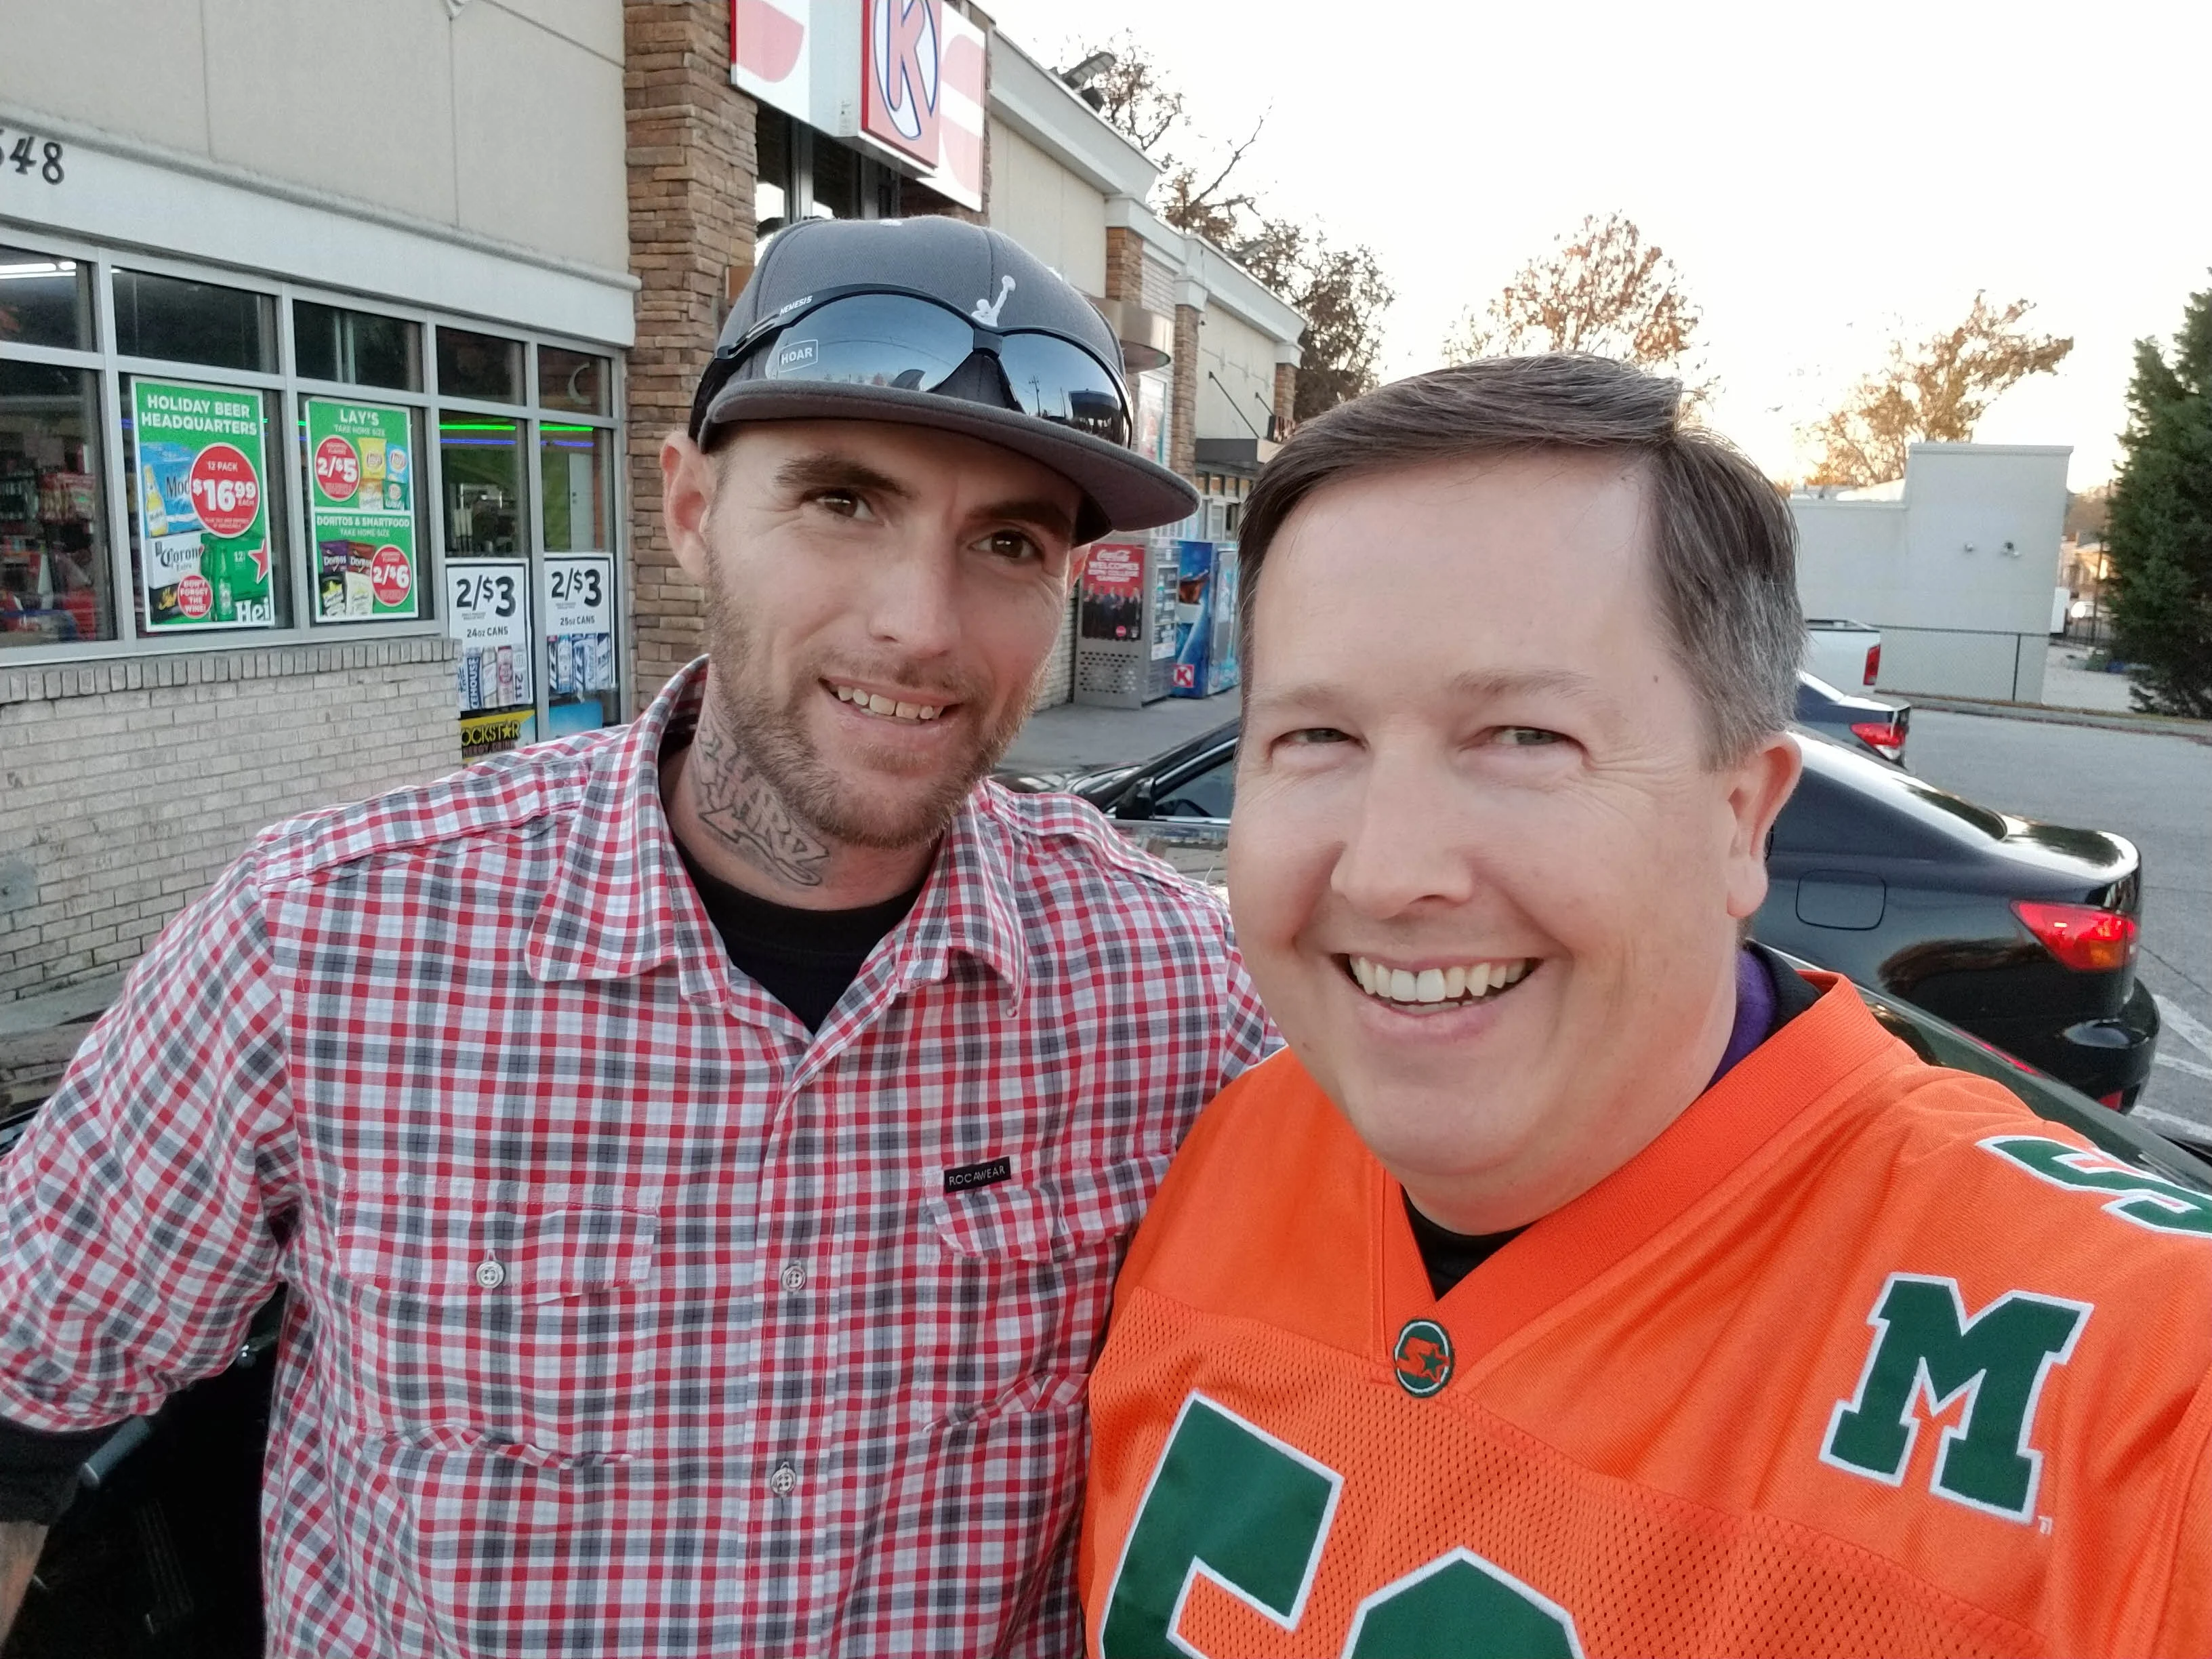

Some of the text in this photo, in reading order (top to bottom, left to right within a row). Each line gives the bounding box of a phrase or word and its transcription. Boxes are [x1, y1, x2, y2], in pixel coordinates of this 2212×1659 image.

[779, 295, 813, 316] NEMESIS
[781, 347, 813, 365] HOAR
[147, 394, 250, 418] HOLIDAY BEER
[141, 412, 257, 436] HEADQUARTERS
[340, 409, 380, 426] LAY'S
[207, 461, 238, 472] 12 PACK
[316, 515, 353, 527] DORITOS
[362, 517, 410, 527] SMARTFOOD
[161, 547, 201, 567] Coron
[456, 575, 516, 617] 2/$3
[551, 567, 602, 607] 2/$3
[188, 596, 203, 605] THE
[577, 615, 595, 625] CANS
[487, 626, 509, 638] CANS
[949, 1165, 1006, 1187] ROCAWEAR
[1819, 1272, 2095, 1524] M
